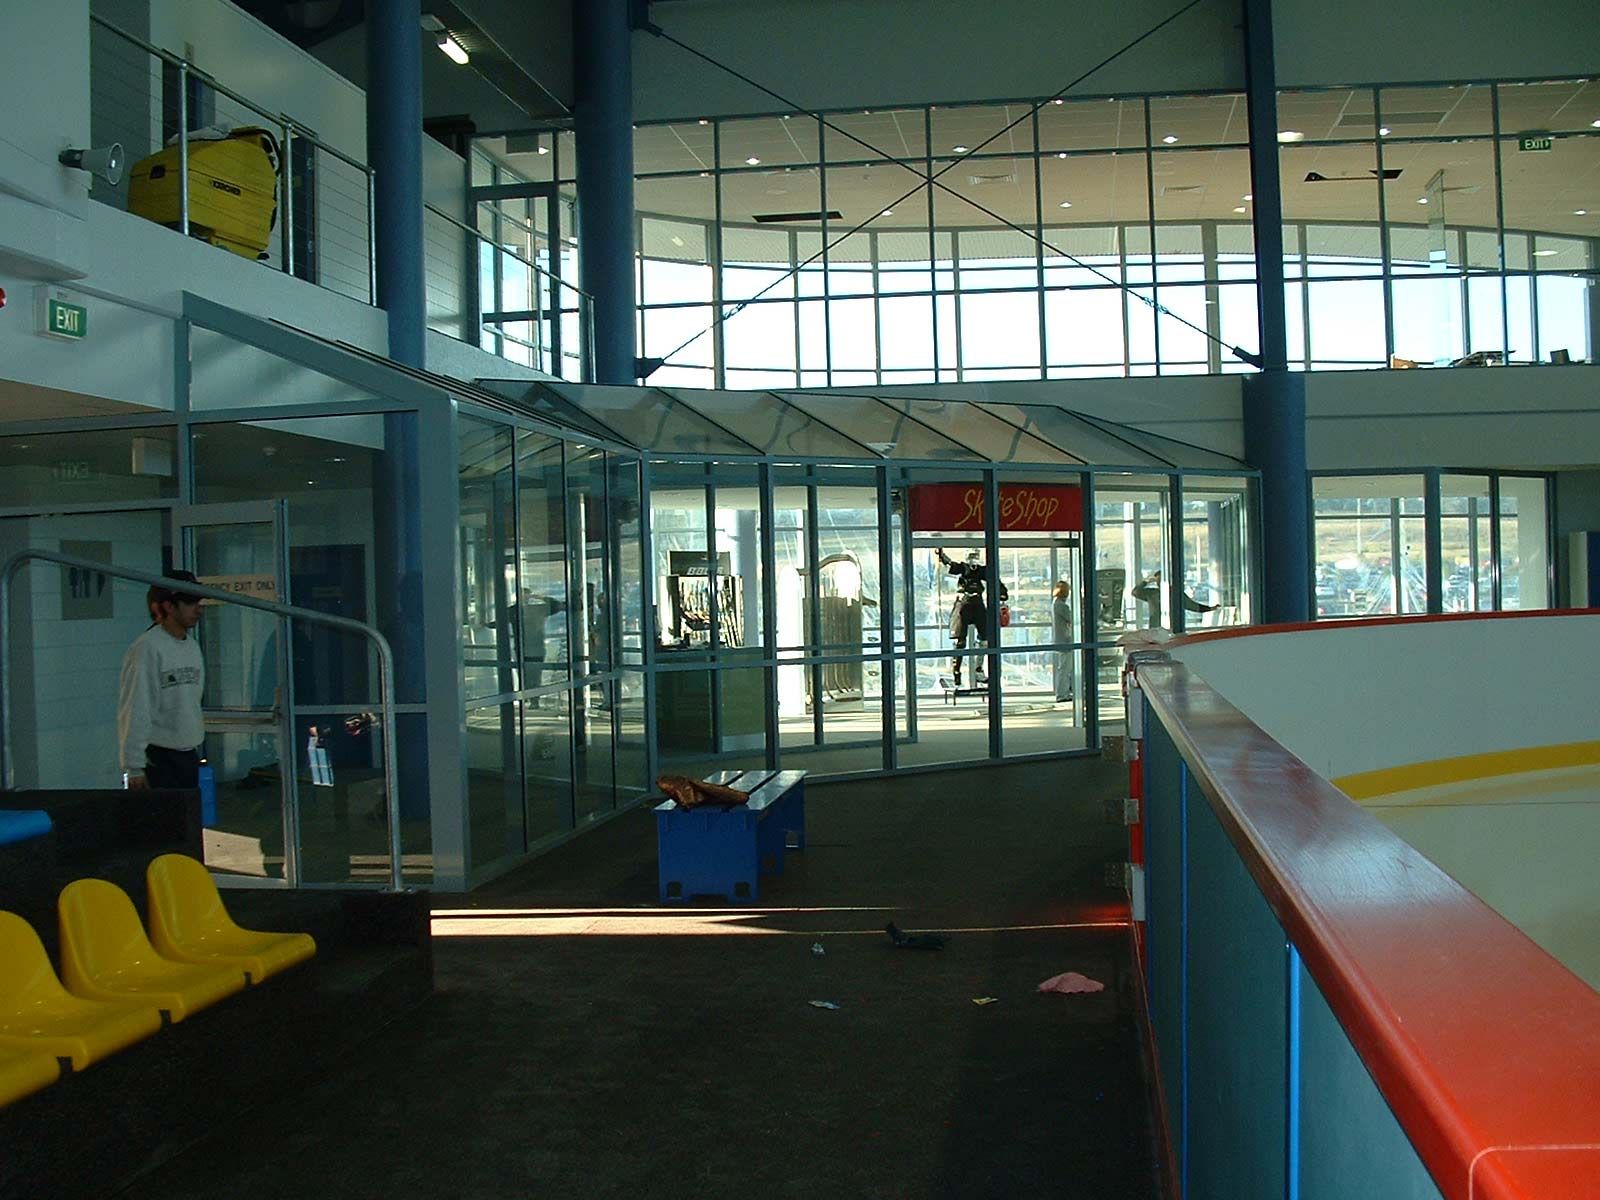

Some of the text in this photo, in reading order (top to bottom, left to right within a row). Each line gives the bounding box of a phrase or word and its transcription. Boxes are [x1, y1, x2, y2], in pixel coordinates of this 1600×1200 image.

[1525, 139, 1544, 150] EXIT
[56, 306, 80, 332] EXIT
[234, 581, 252, 591] EXIT
[256, 580, 275, 591] ONLY
